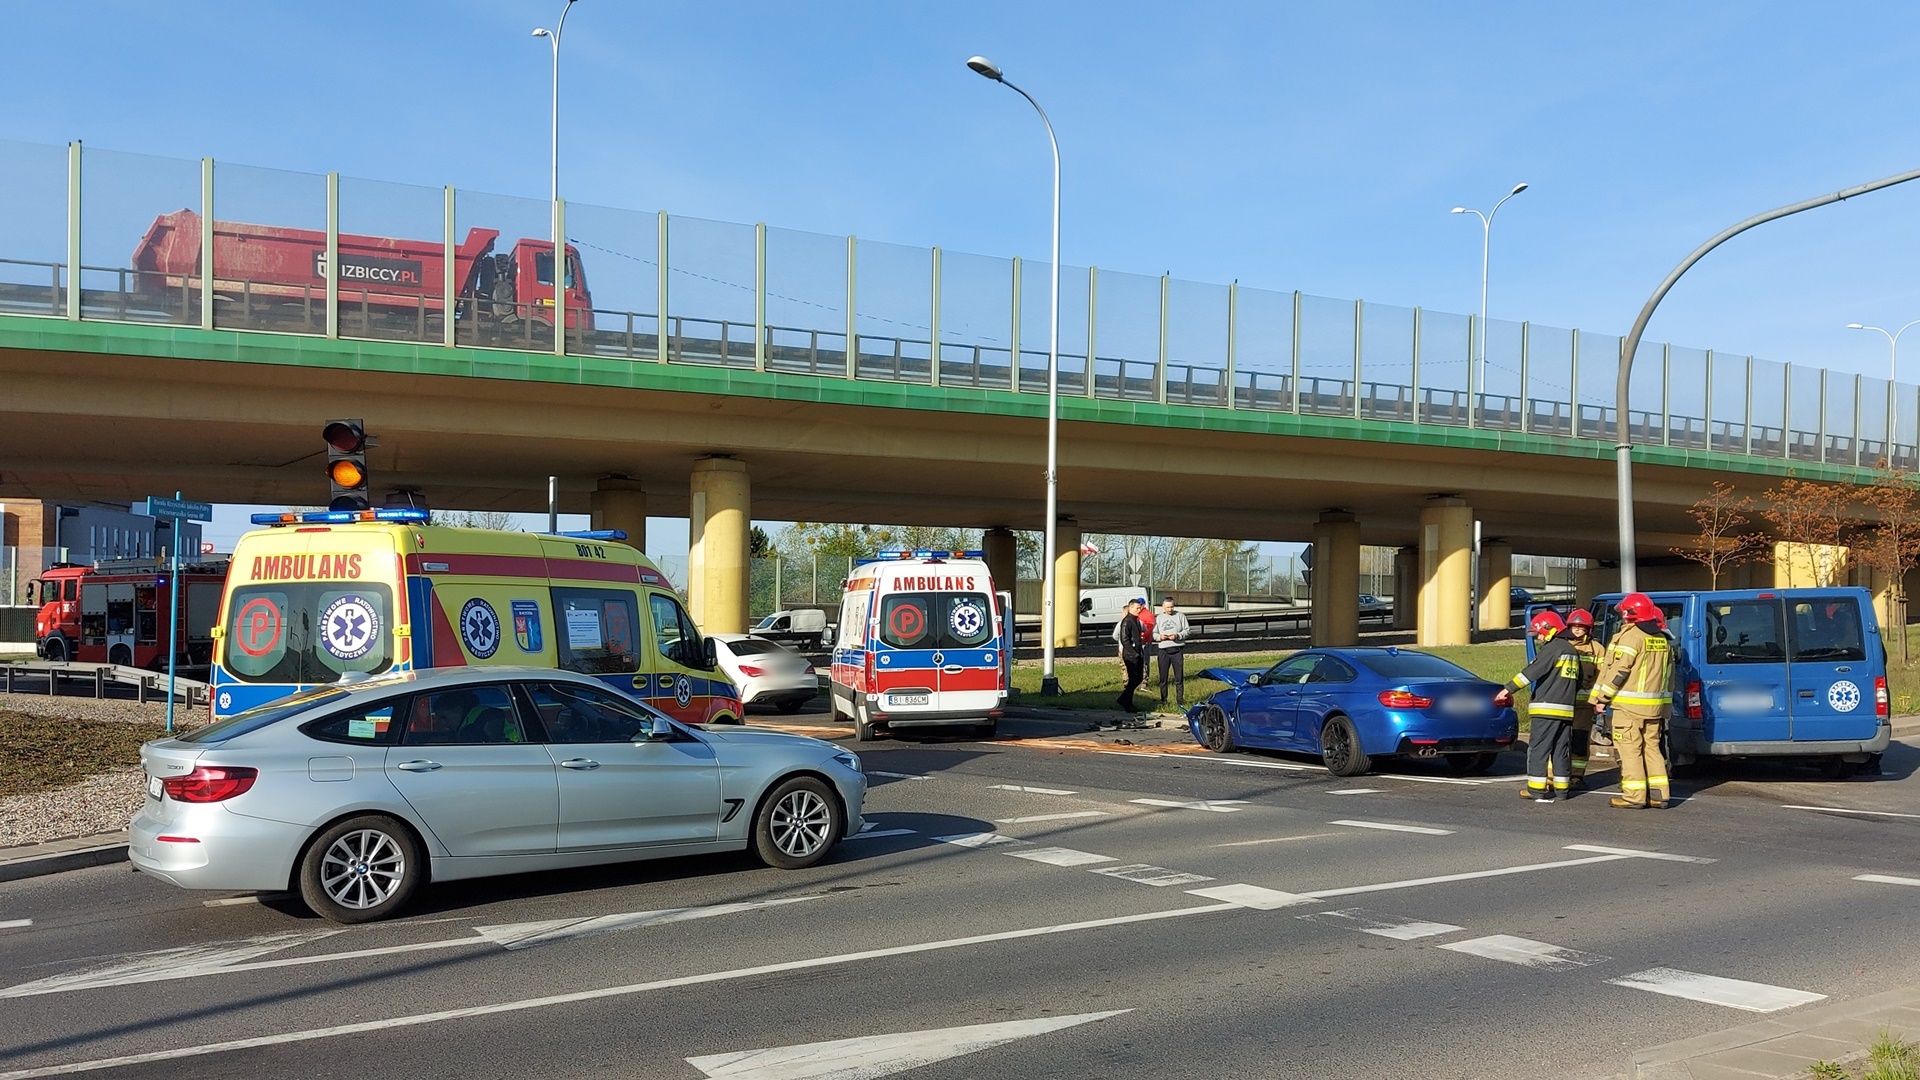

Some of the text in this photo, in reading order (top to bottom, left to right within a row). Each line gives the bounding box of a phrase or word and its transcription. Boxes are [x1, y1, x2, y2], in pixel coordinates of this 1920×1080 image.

[341, 264, 419, 283] IZBICCY.PL
[594, 546, 607, 559] 42
[250, 553, 362, 580] AMBULANS
[893, 576, 975, 591] AMBULANS
[354, 597, 379, 640] RATOWNICTWO
[901, 612, 914, 632] P
[1622, 610, 1628, 618] 2
[251, 611, 269, 645] P
[329, 646, 368, 659] MEDYCZNE
